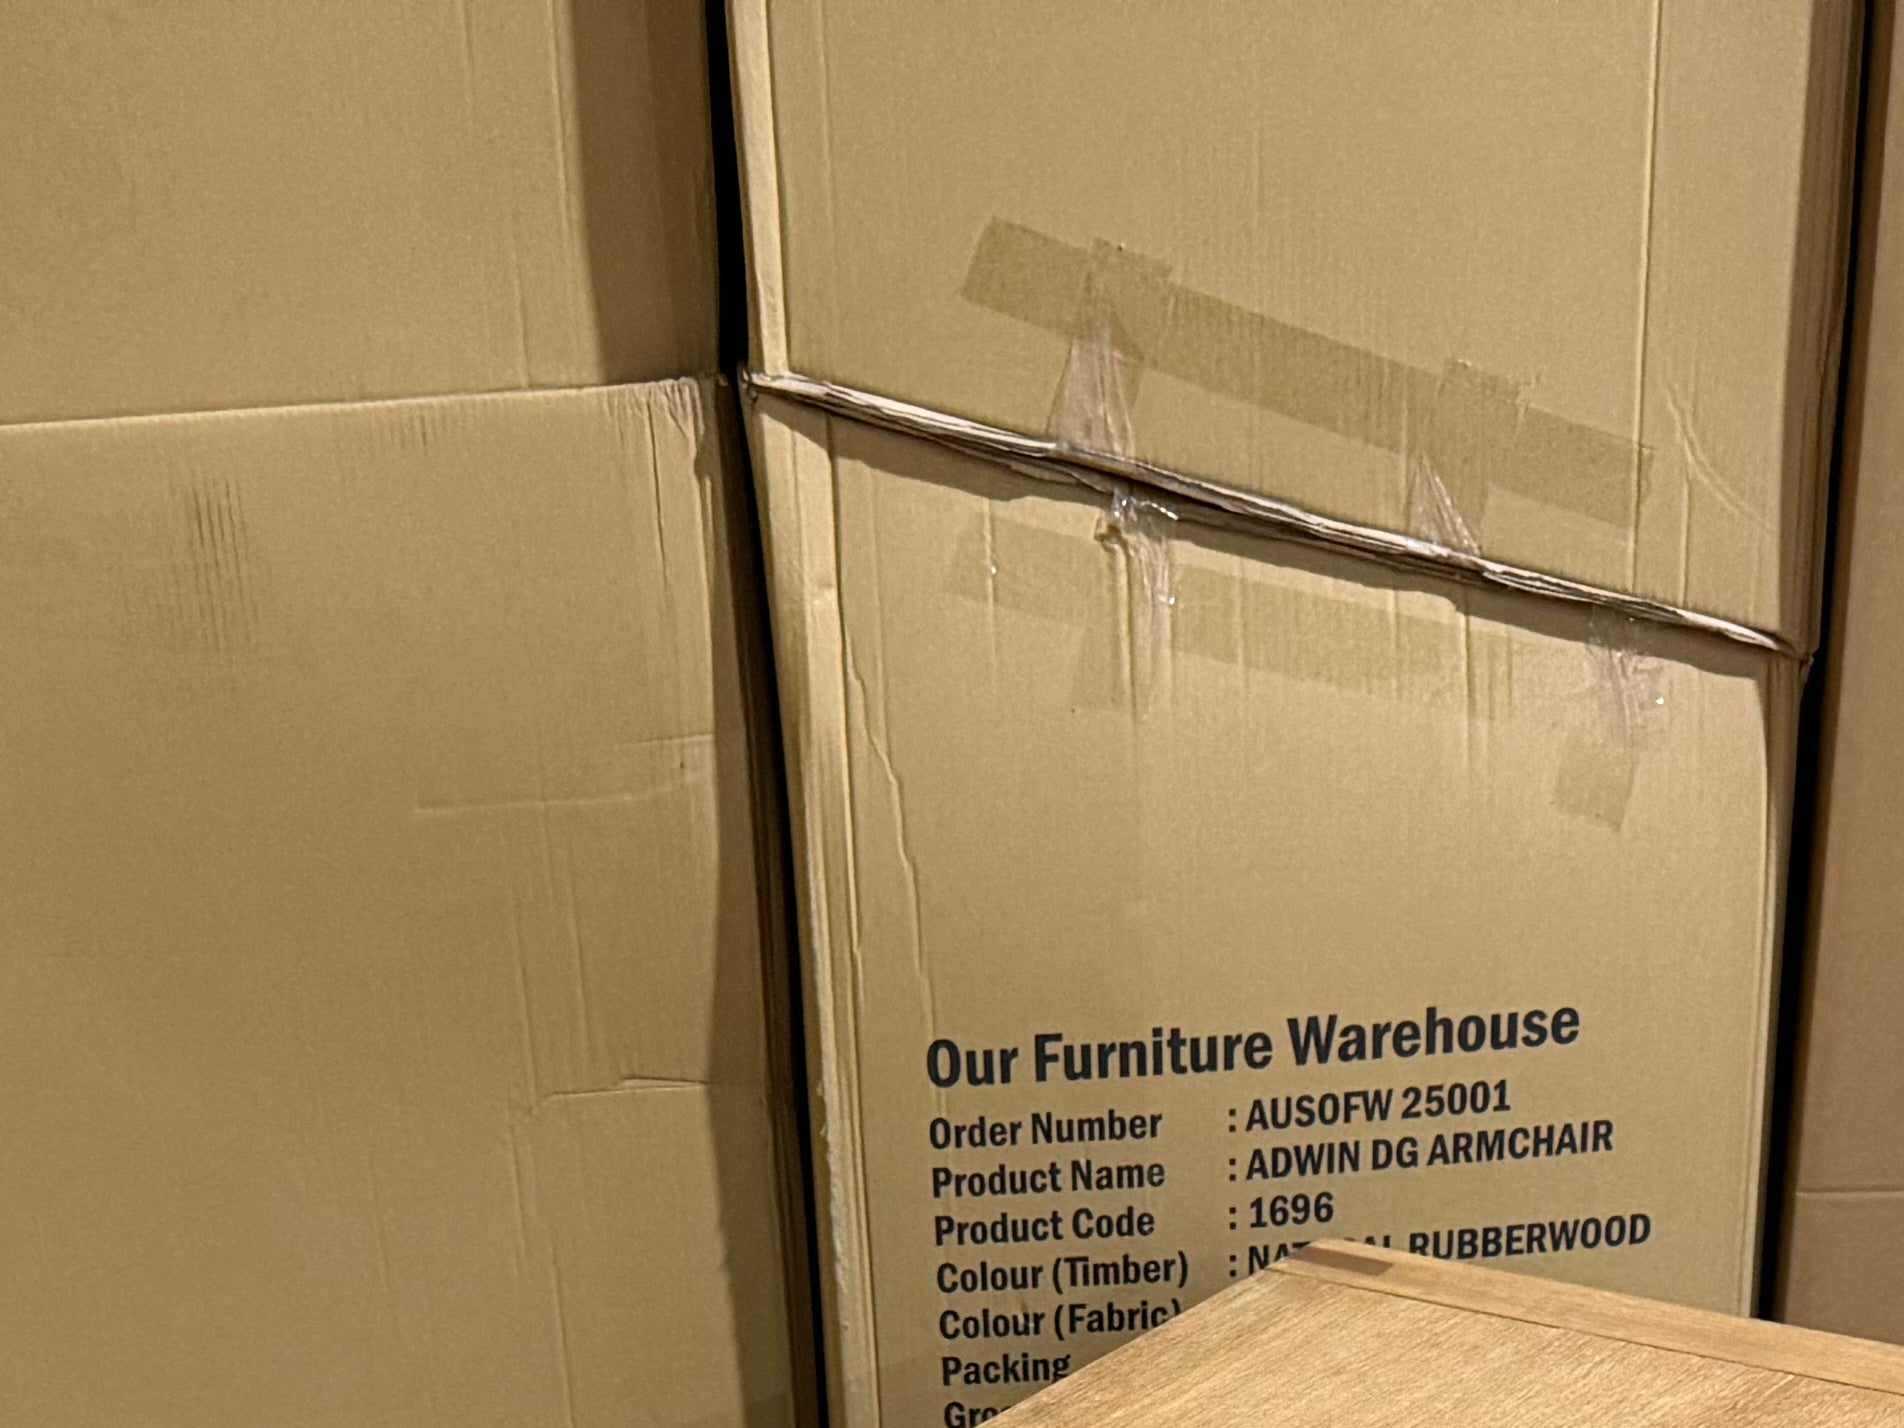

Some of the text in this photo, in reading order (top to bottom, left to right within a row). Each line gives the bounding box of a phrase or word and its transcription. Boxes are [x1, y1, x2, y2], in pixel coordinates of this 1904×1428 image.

[925, 1005, 1581, 1089] Our Furniture Warehouse
[927, 1077, 1511, 1150] Order Number AUSOFW 25001
[931, 1118, 1614, 1199] Product Name ADWIN DG ARMCHAIR
[933, 1190, 1335, 1247] Product Code 1696
[935, 1259, 1044, 1294] Colour
[1051, 1249, 1189, 1295] (Timber)
[1407, 1212, 1651, 1261] RUBBERWOOD
[937, 1307, 1046, 1340] Colour
